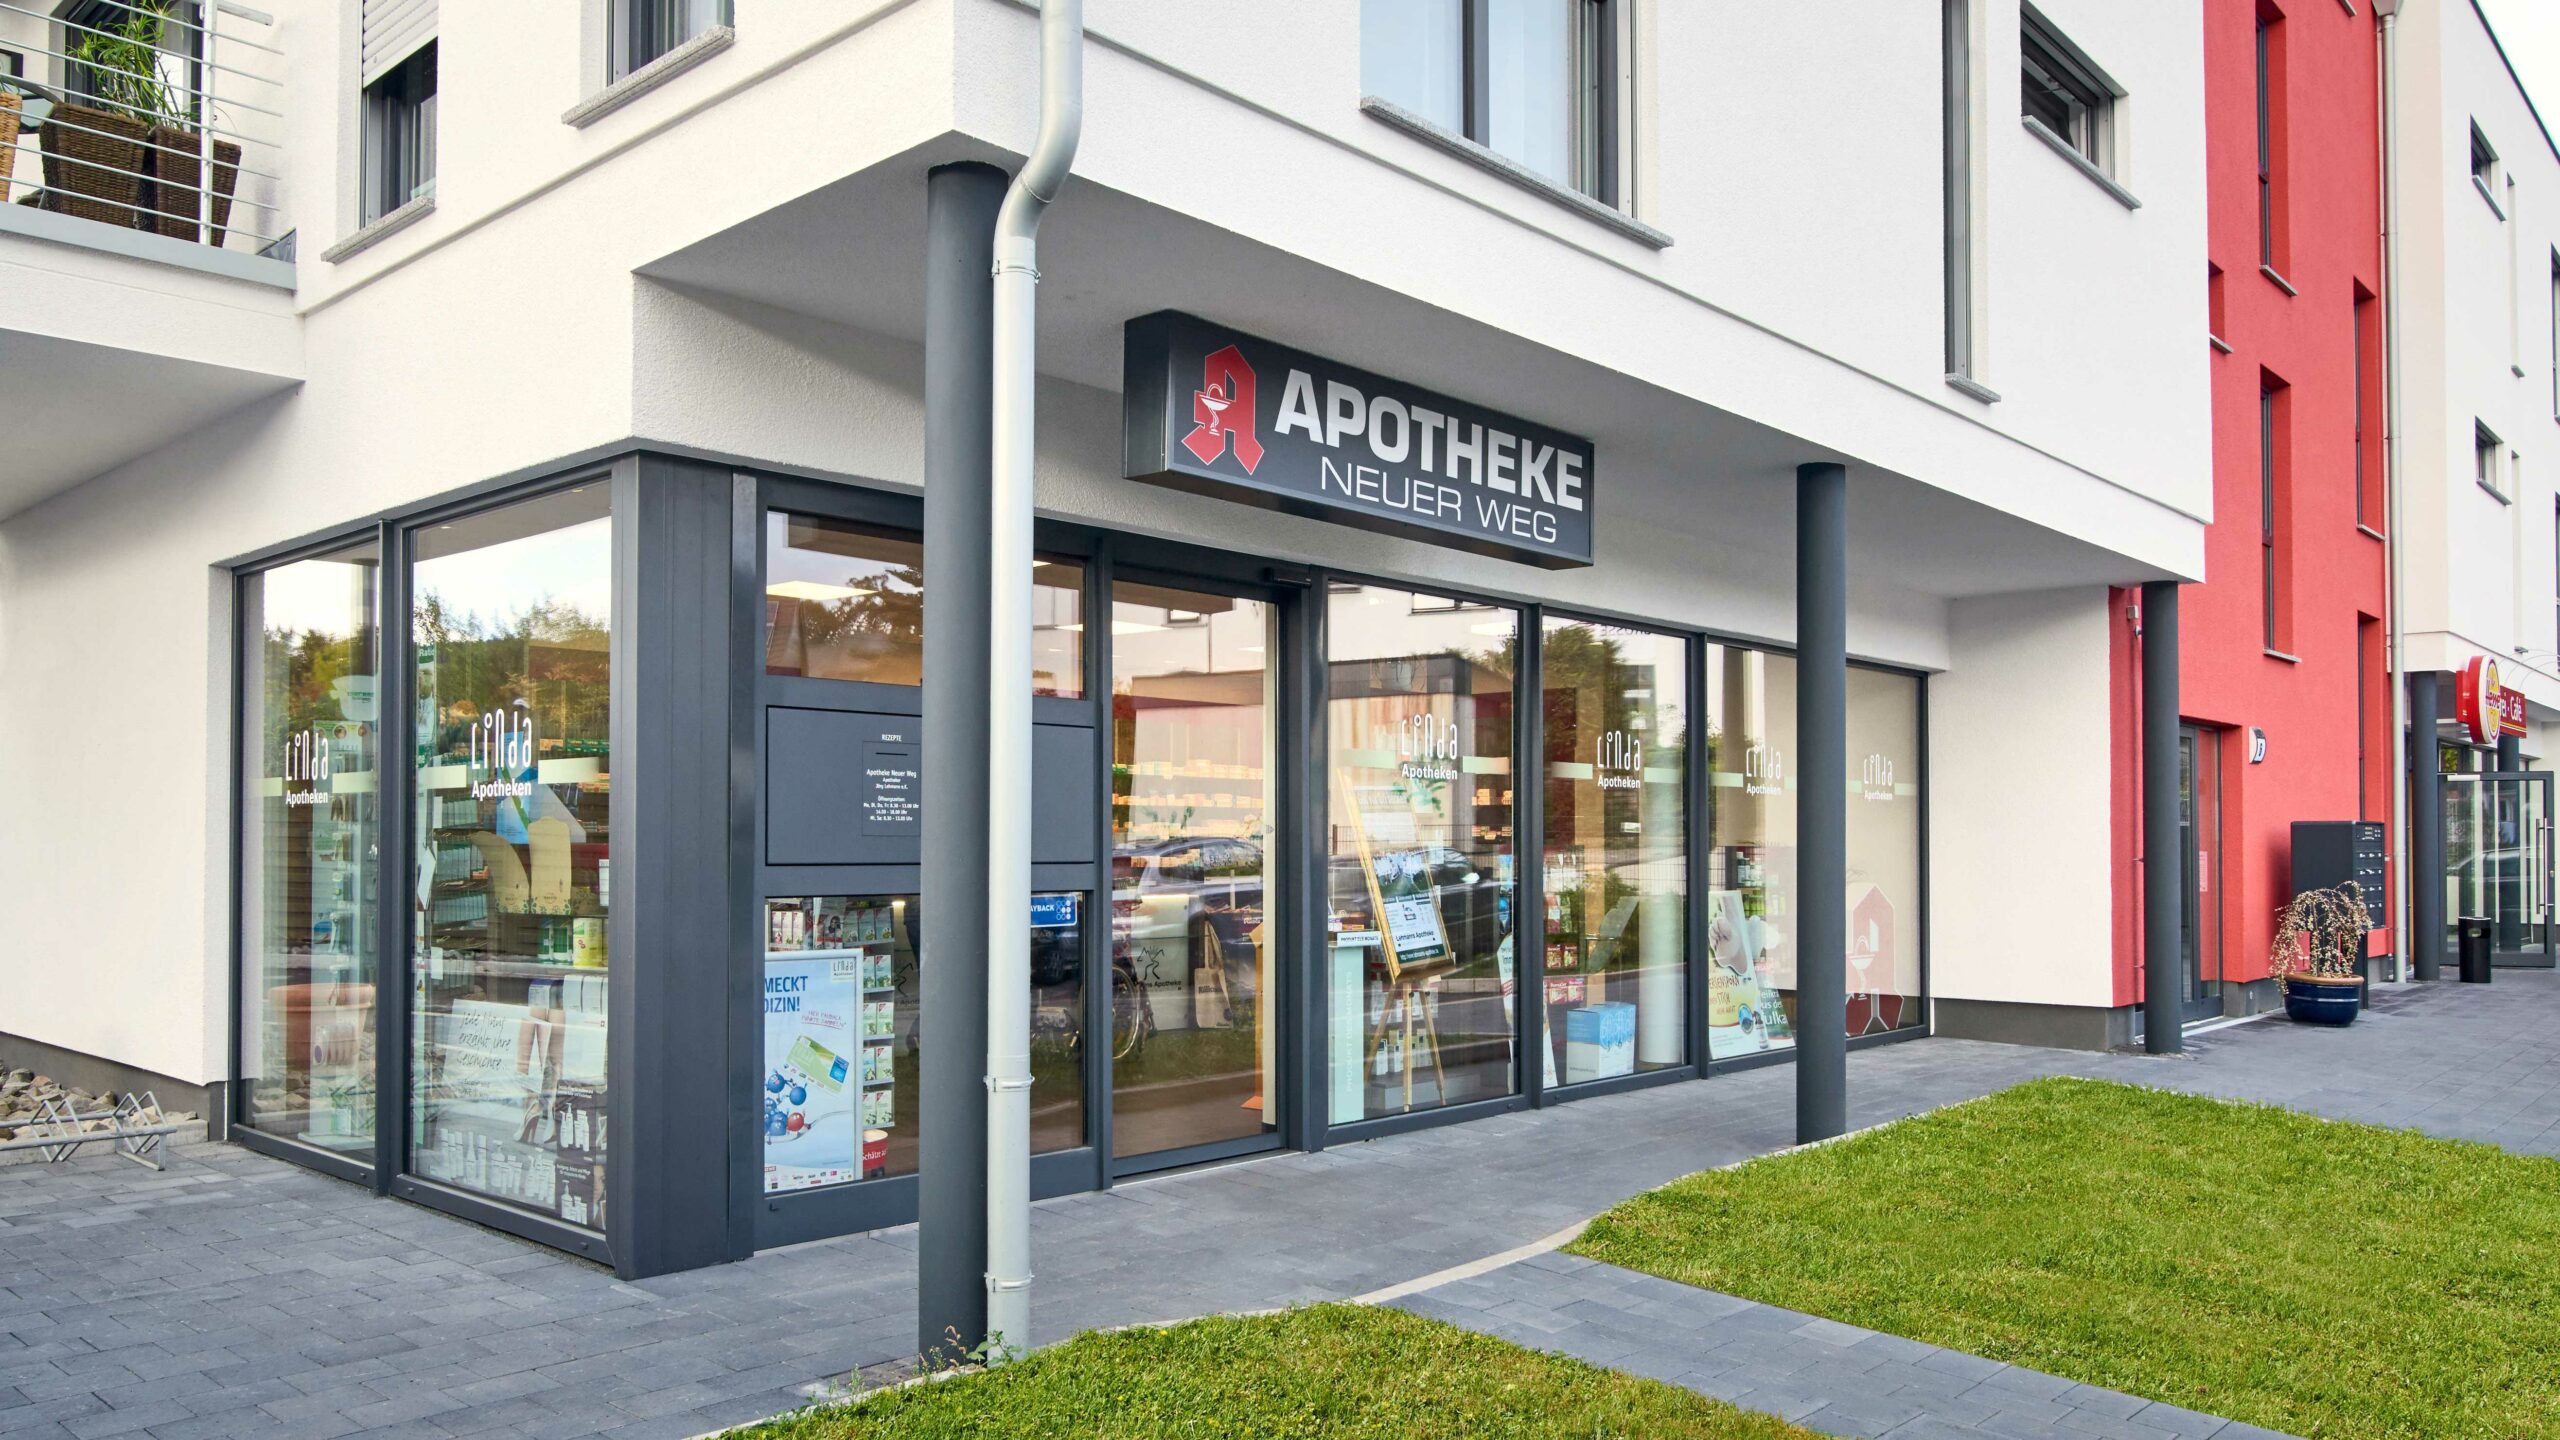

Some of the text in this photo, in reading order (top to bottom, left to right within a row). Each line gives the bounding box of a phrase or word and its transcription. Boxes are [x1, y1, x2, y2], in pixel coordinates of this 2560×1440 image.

[1274, 368, 1583, 512] APOTHEKE
[1321, 456, 1557, 544] NEUER WEG
[881, 734, 902, 742] REZEPTE
[866, 769, 917, 779] Apotheke Neuer Weg
[1401, 763, 1458, 781] Apotheken
[472, 778, 532, 802] Apotheken
[1597, 774, 1641, 790] Apotheken
[1746, 783, 1782, 797] Apotheken
[285, 789, 329, 808] Apotheken
[1864, 790, 1893, 802] Apotheken
